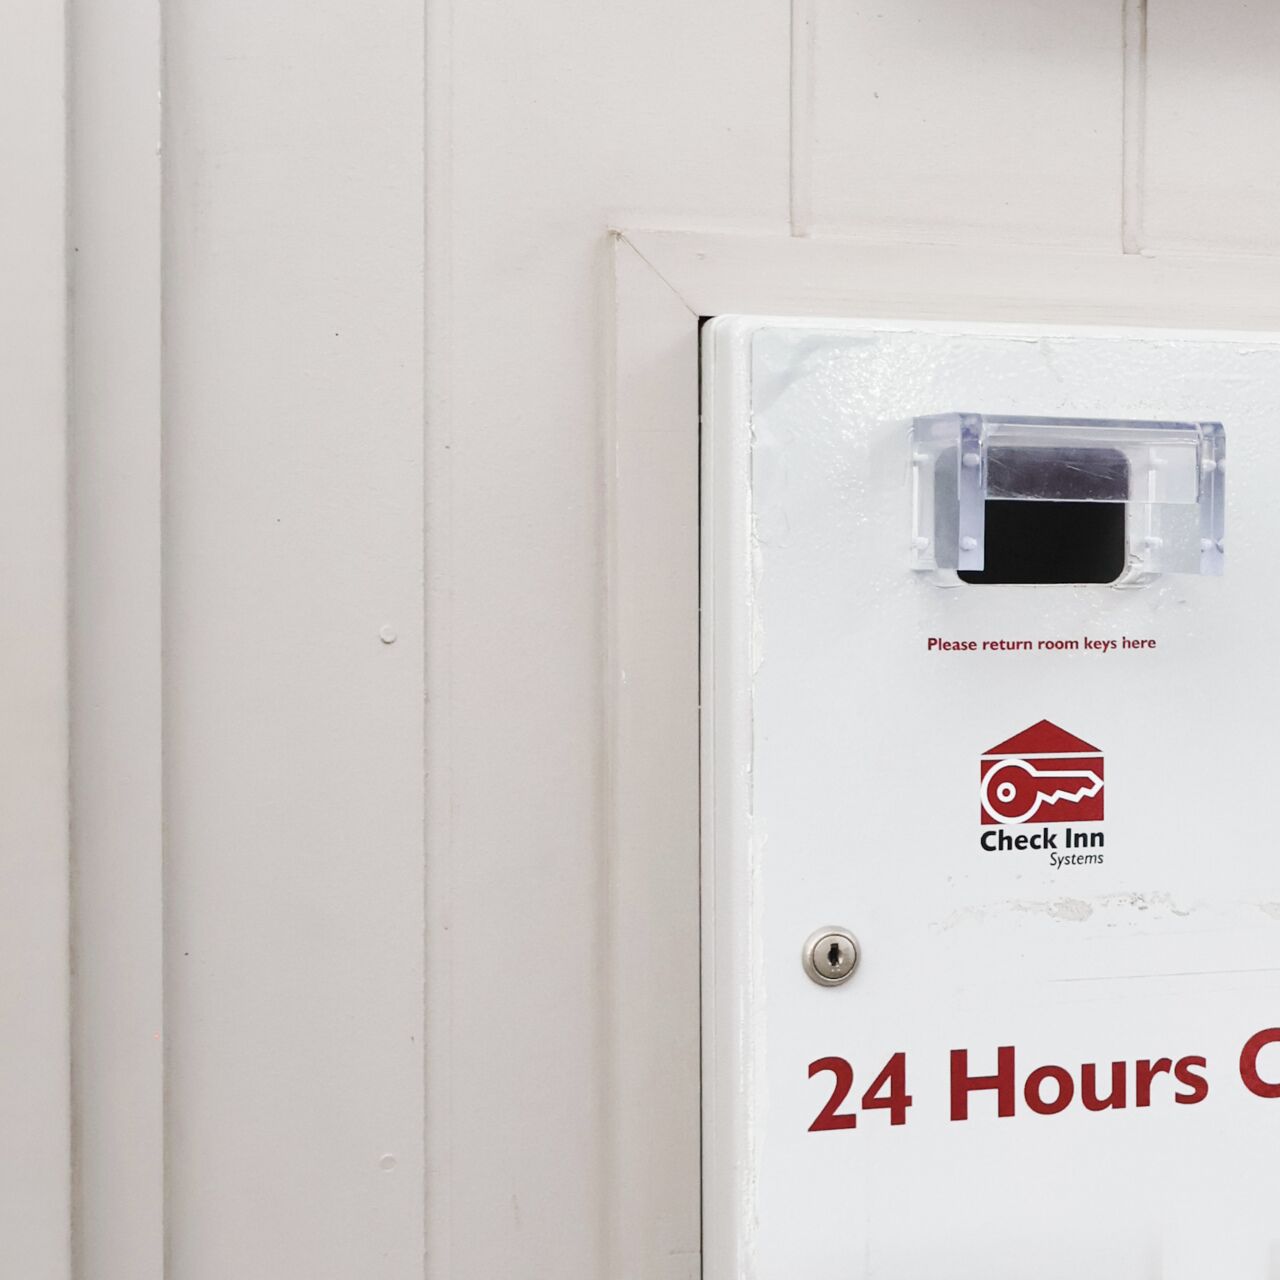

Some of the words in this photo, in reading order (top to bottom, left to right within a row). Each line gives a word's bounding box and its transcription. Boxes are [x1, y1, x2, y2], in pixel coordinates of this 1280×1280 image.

[927, 637, 978, 652] Please
[982, 639, 1033, 651] return
[1037, 639, 1080, 651] room
[1083, 636, 1118, 654] keys
[1121, 635, 1157, 650] here
[980, 827, 1058, 852] Check
[1065, 827, 1105, 849] Inn
[1049, 851, 1104, 870] Systems
[807, 1051, 913, 1133] 24
[949, 1045, 1209, 1122] Hours
